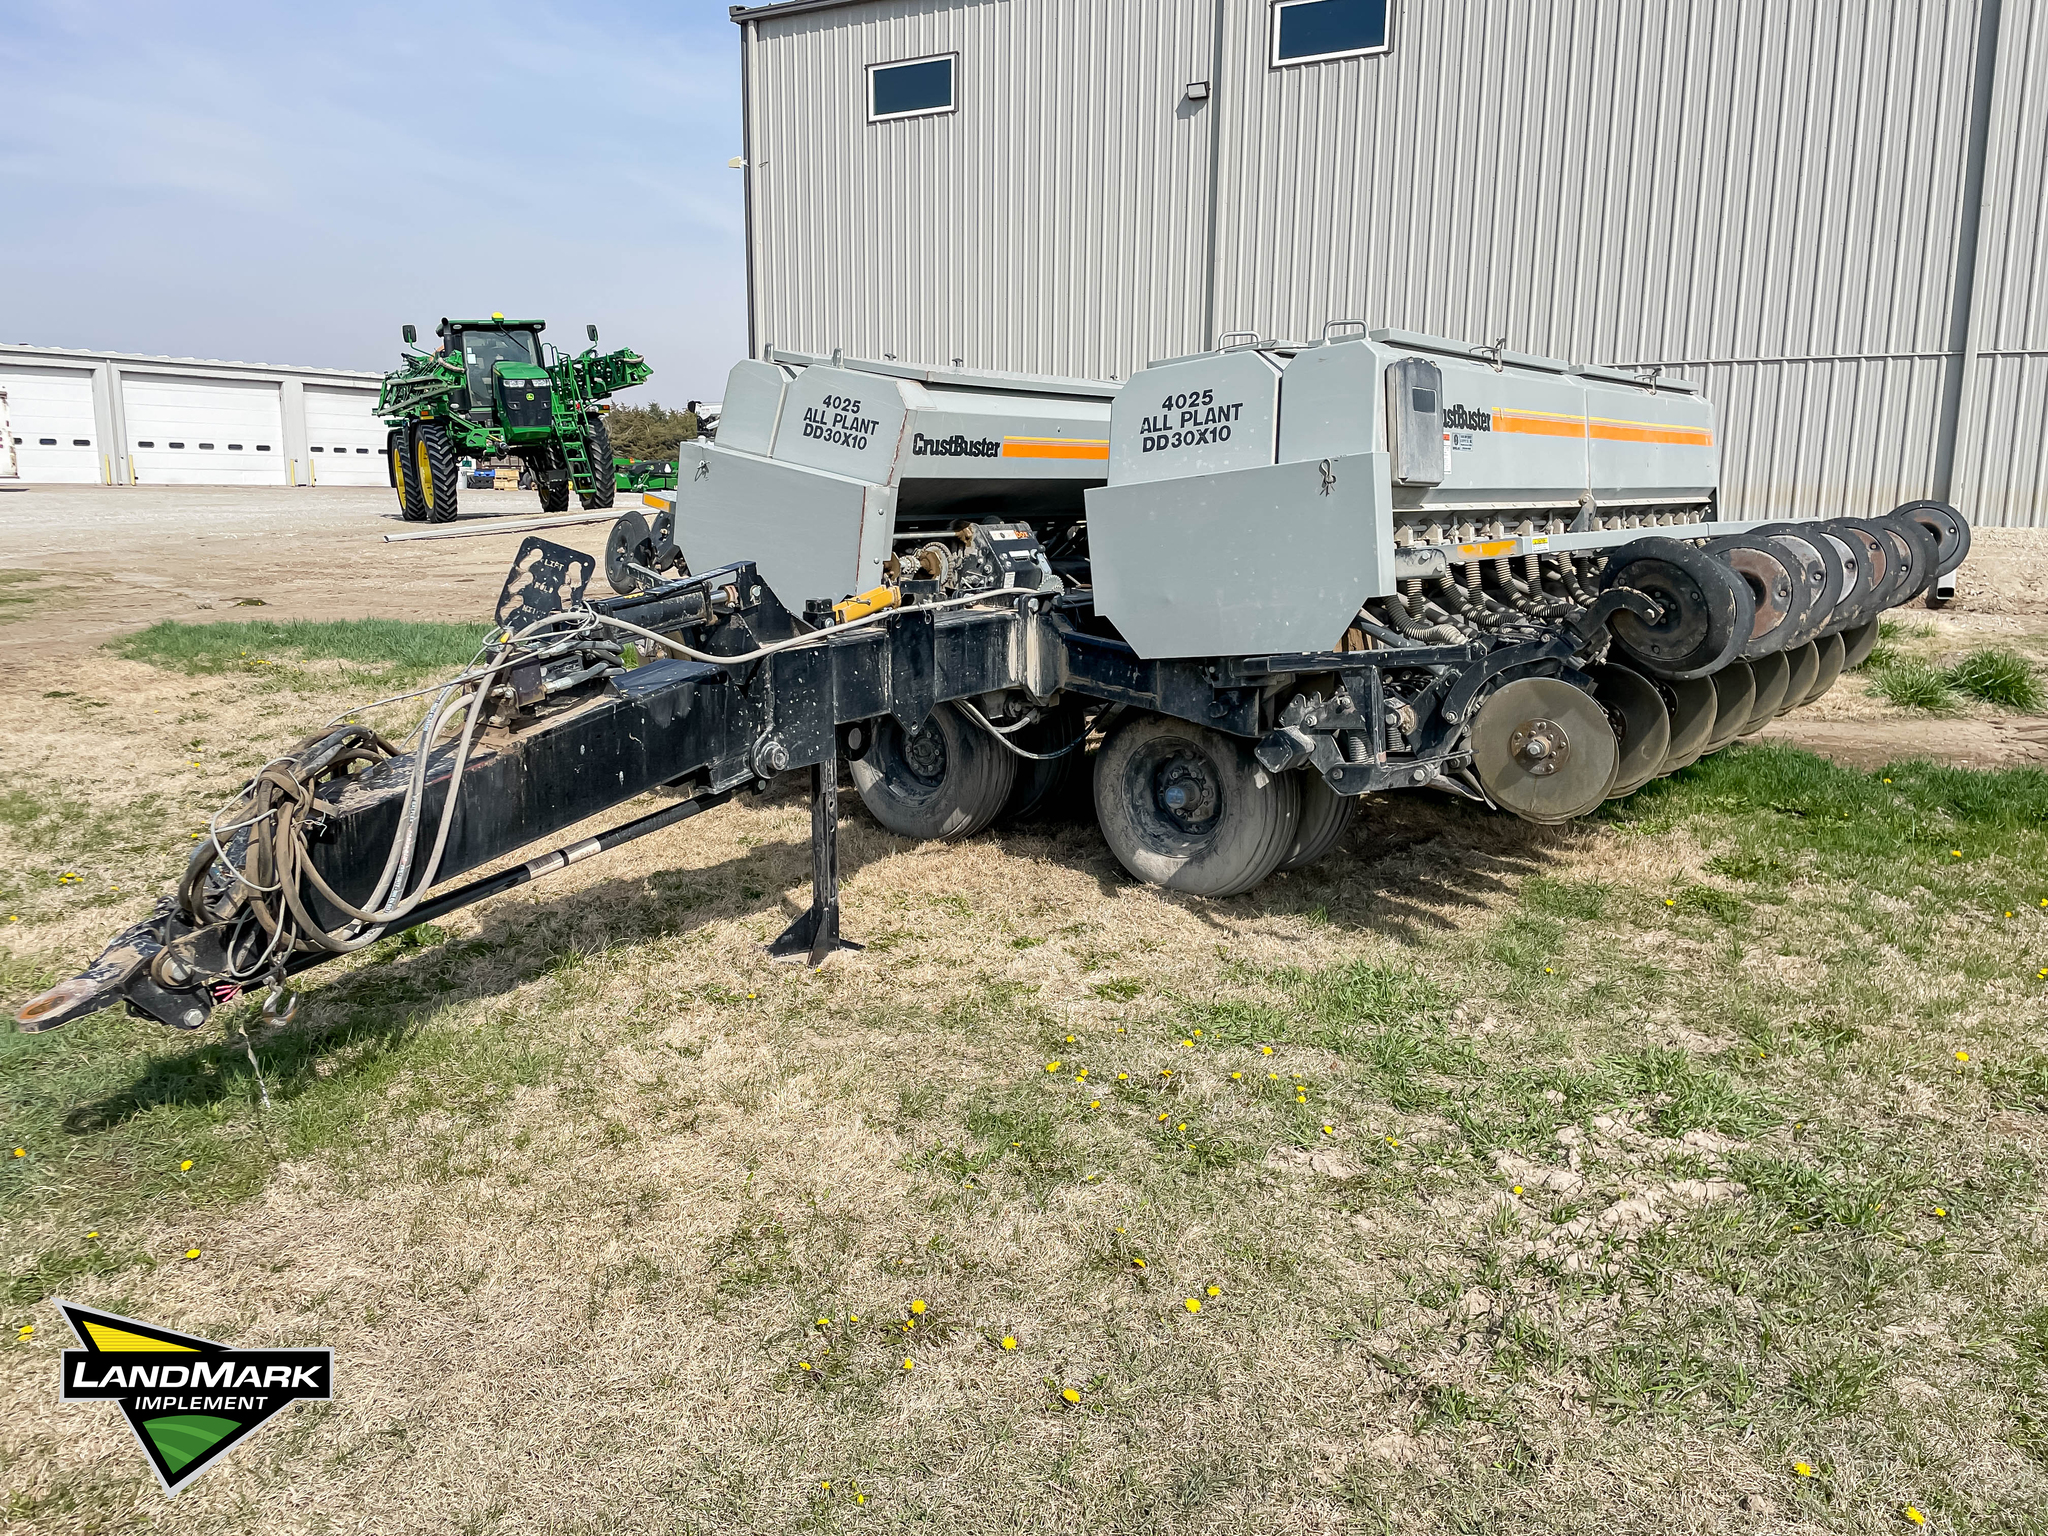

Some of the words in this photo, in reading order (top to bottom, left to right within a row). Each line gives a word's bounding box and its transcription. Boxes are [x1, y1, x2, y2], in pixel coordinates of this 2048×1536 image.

[822, 394, 861, 414] 4025
[1162, 389, 1213, 411] 4025
[803, 407, 827, 426] ALL
[832, 413, 879, 435] PLANT
[1140, 414, 1172, 434] ALL
[1180, 403, 1243, 428] PLANT
[1443, 404, 1491, 432] ustBuster
[803, 422, 867, 450] DD30X10
[912, 432, 1000, 458] CrustBuster
[1142, 425, 1231, 453] DD30X10
